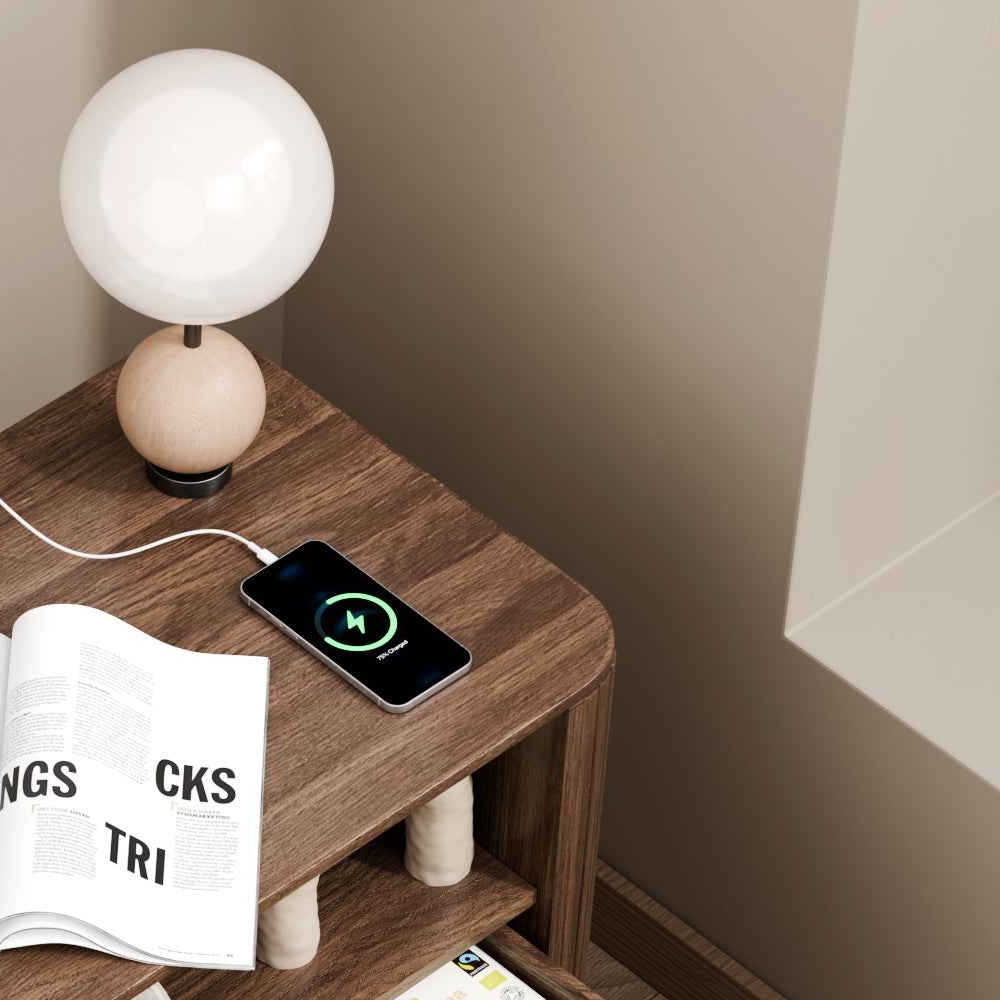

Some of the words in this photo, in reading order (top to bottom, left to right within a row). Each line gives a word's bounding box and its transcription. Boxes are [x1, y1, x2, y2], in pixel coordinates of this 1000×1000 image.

[377, 652, 389, 661] 75%
[388, 640, 408, 654] Charged
[156, 758, 236, 805] CKS
[105, 822, 166, 886] TRI
